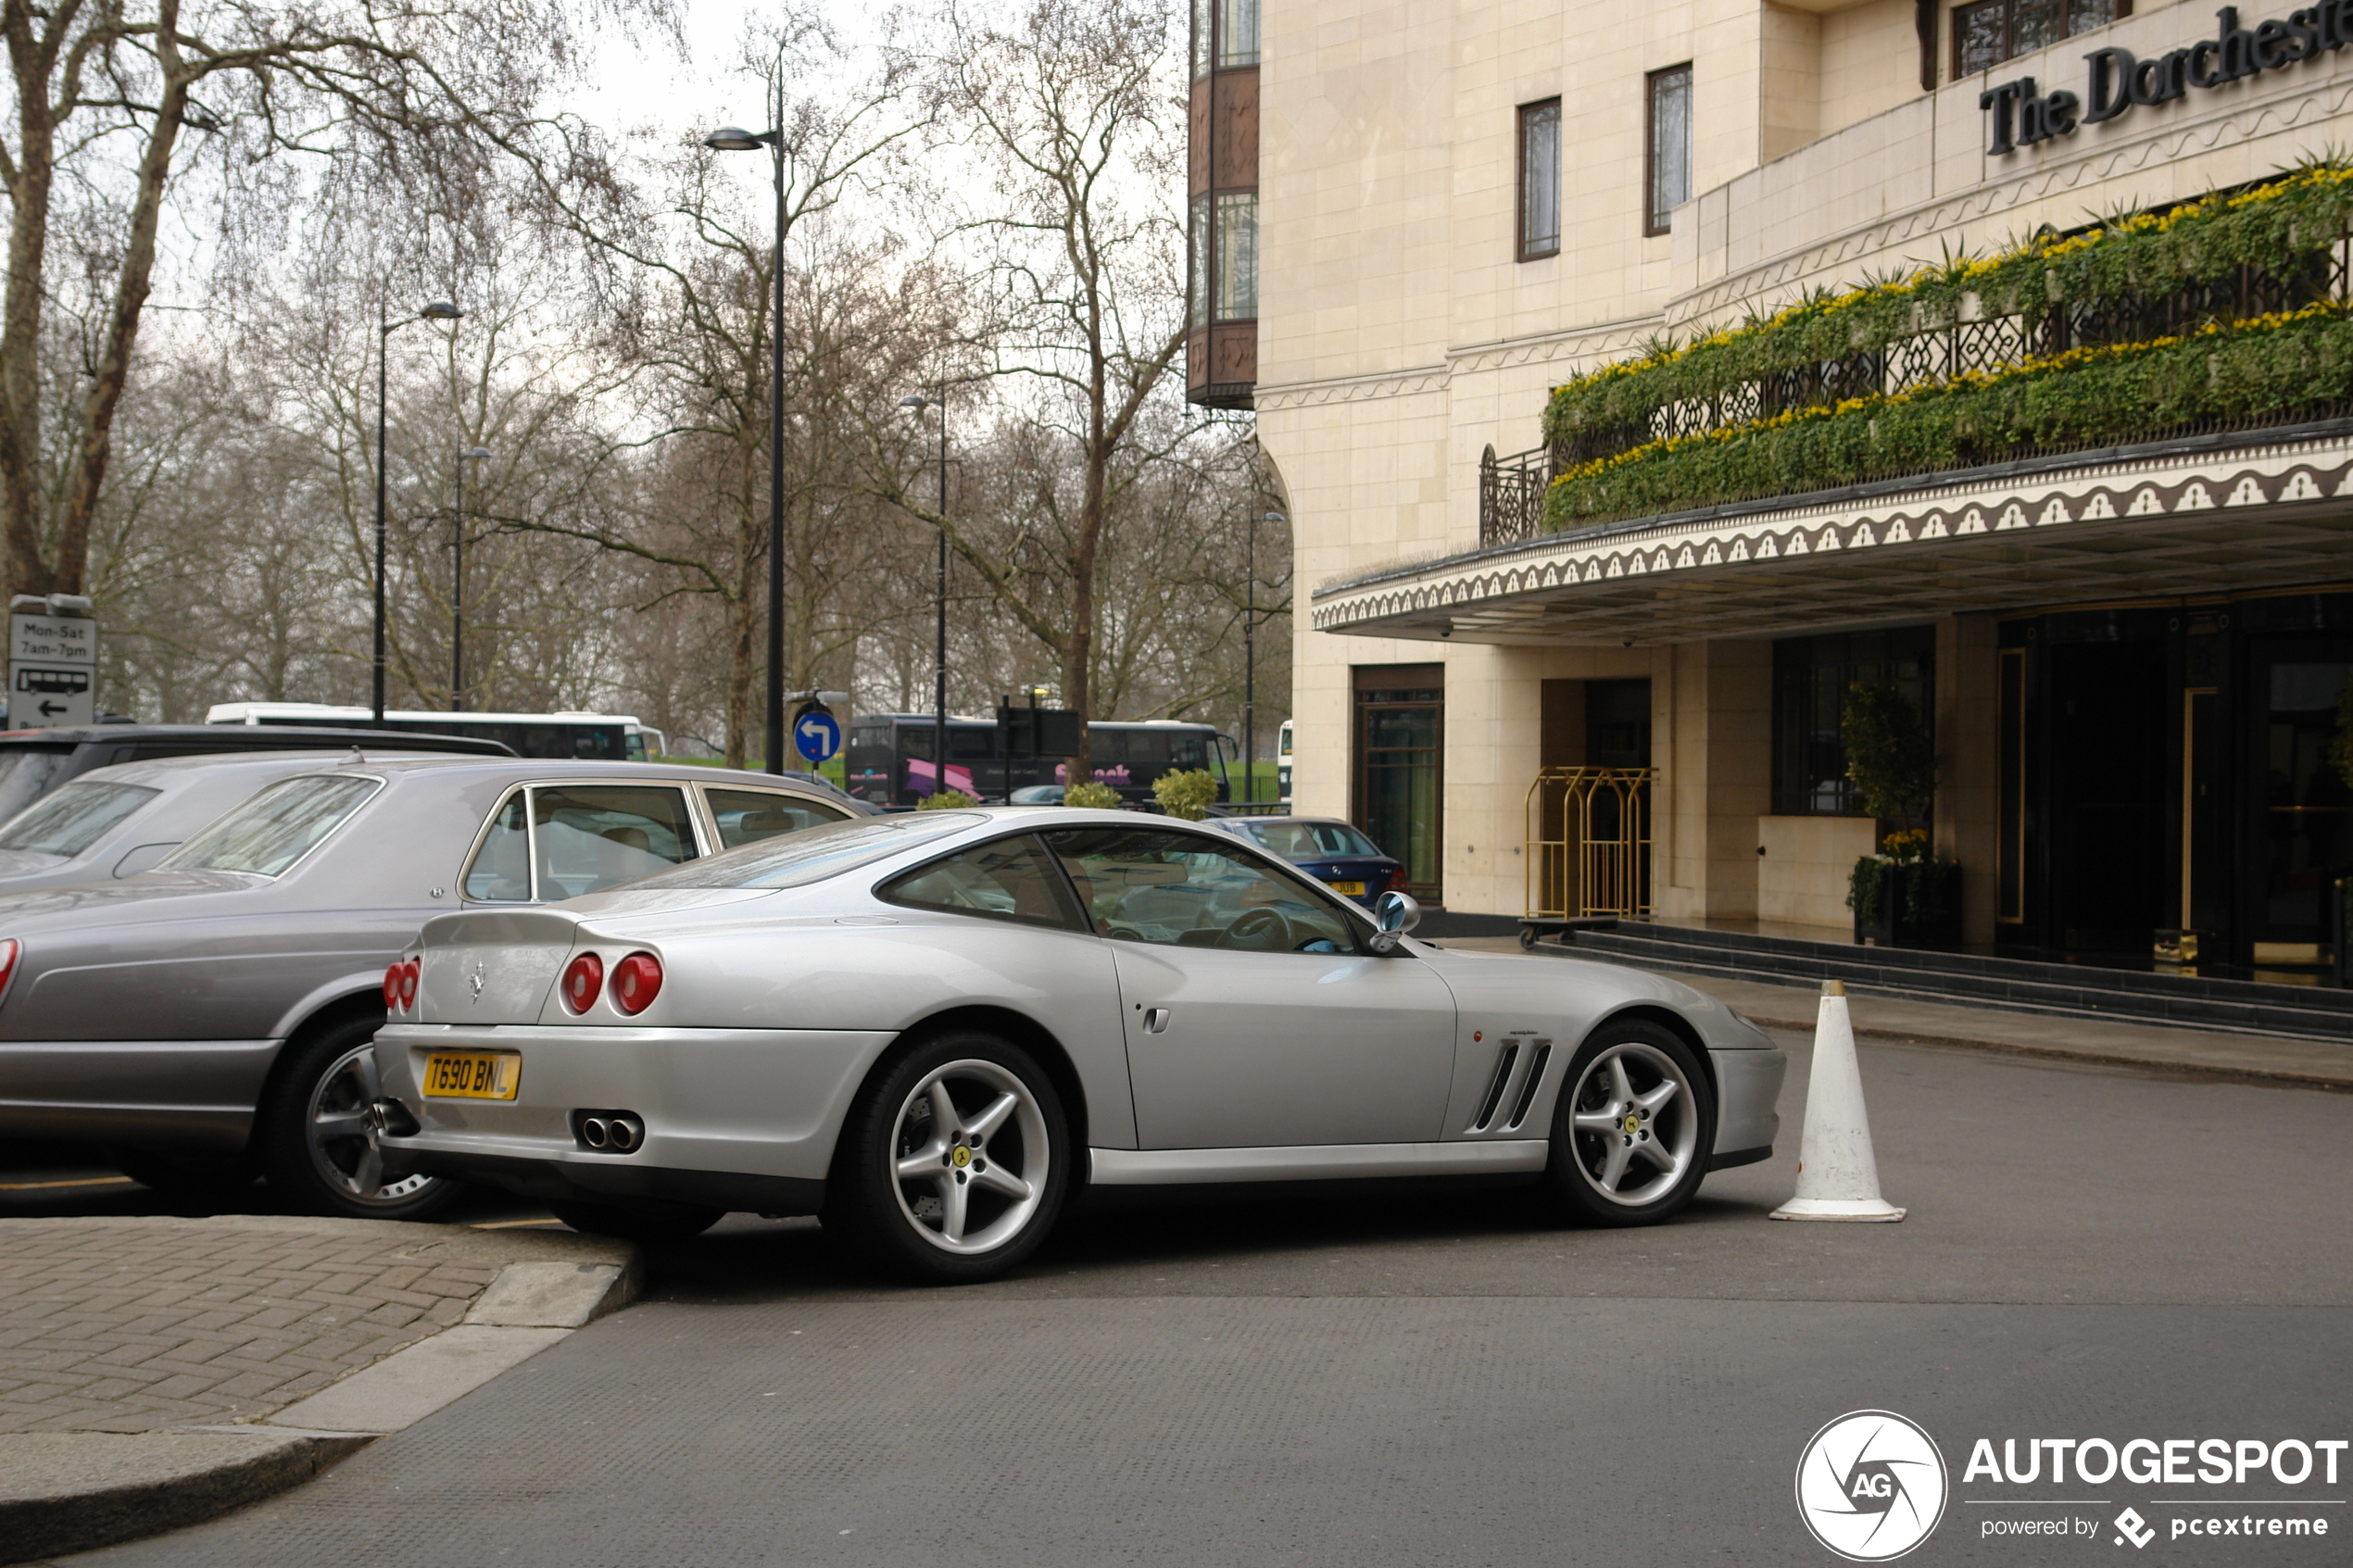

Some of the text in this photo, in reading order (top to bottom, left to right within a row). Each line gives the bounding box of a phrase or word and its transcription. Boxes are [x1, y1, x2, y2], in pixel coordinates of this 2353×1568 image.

[1980, 76, 2077, 156] The
[24, 623, 84, 639] Mon-Sat
[21, 641, 86, 657] 7am-7pm
[431, 1058, 508, 1093] T690 BNL
